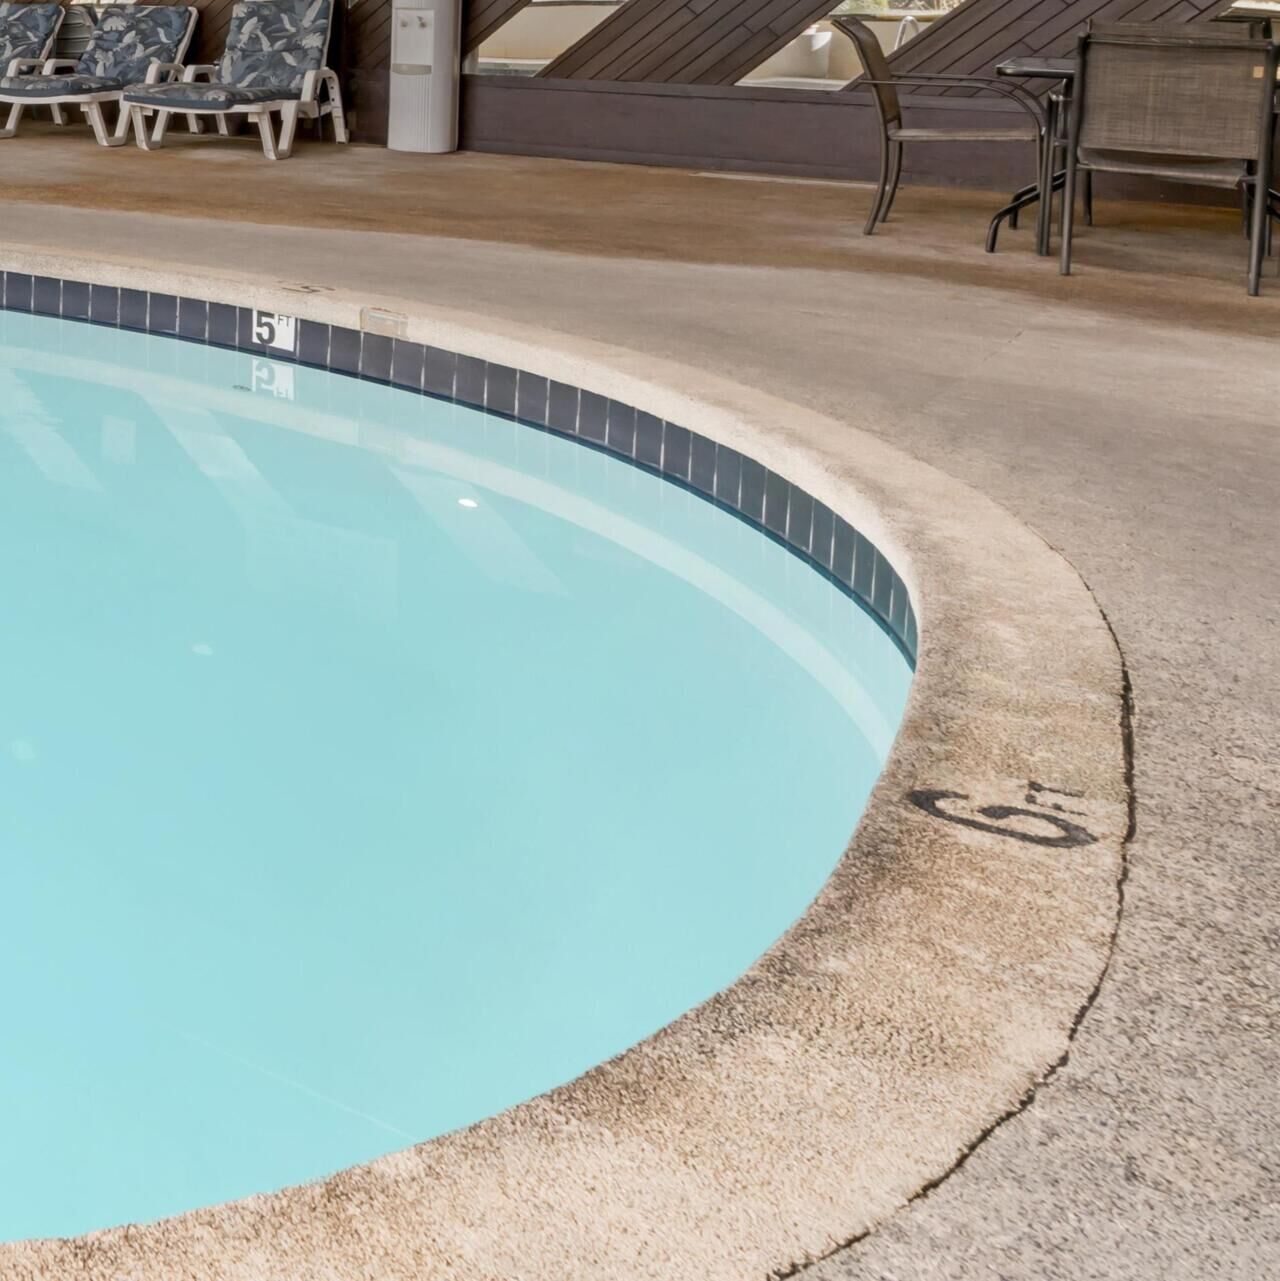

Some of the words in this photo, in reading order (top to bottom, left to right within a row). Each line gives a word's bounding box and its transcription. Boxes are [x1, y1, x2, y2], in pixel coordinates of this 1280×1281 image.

[255, 309, 276, 345] 5
[277, 313, 292, 328] FT
[906, 787, 1100, 849] 6
